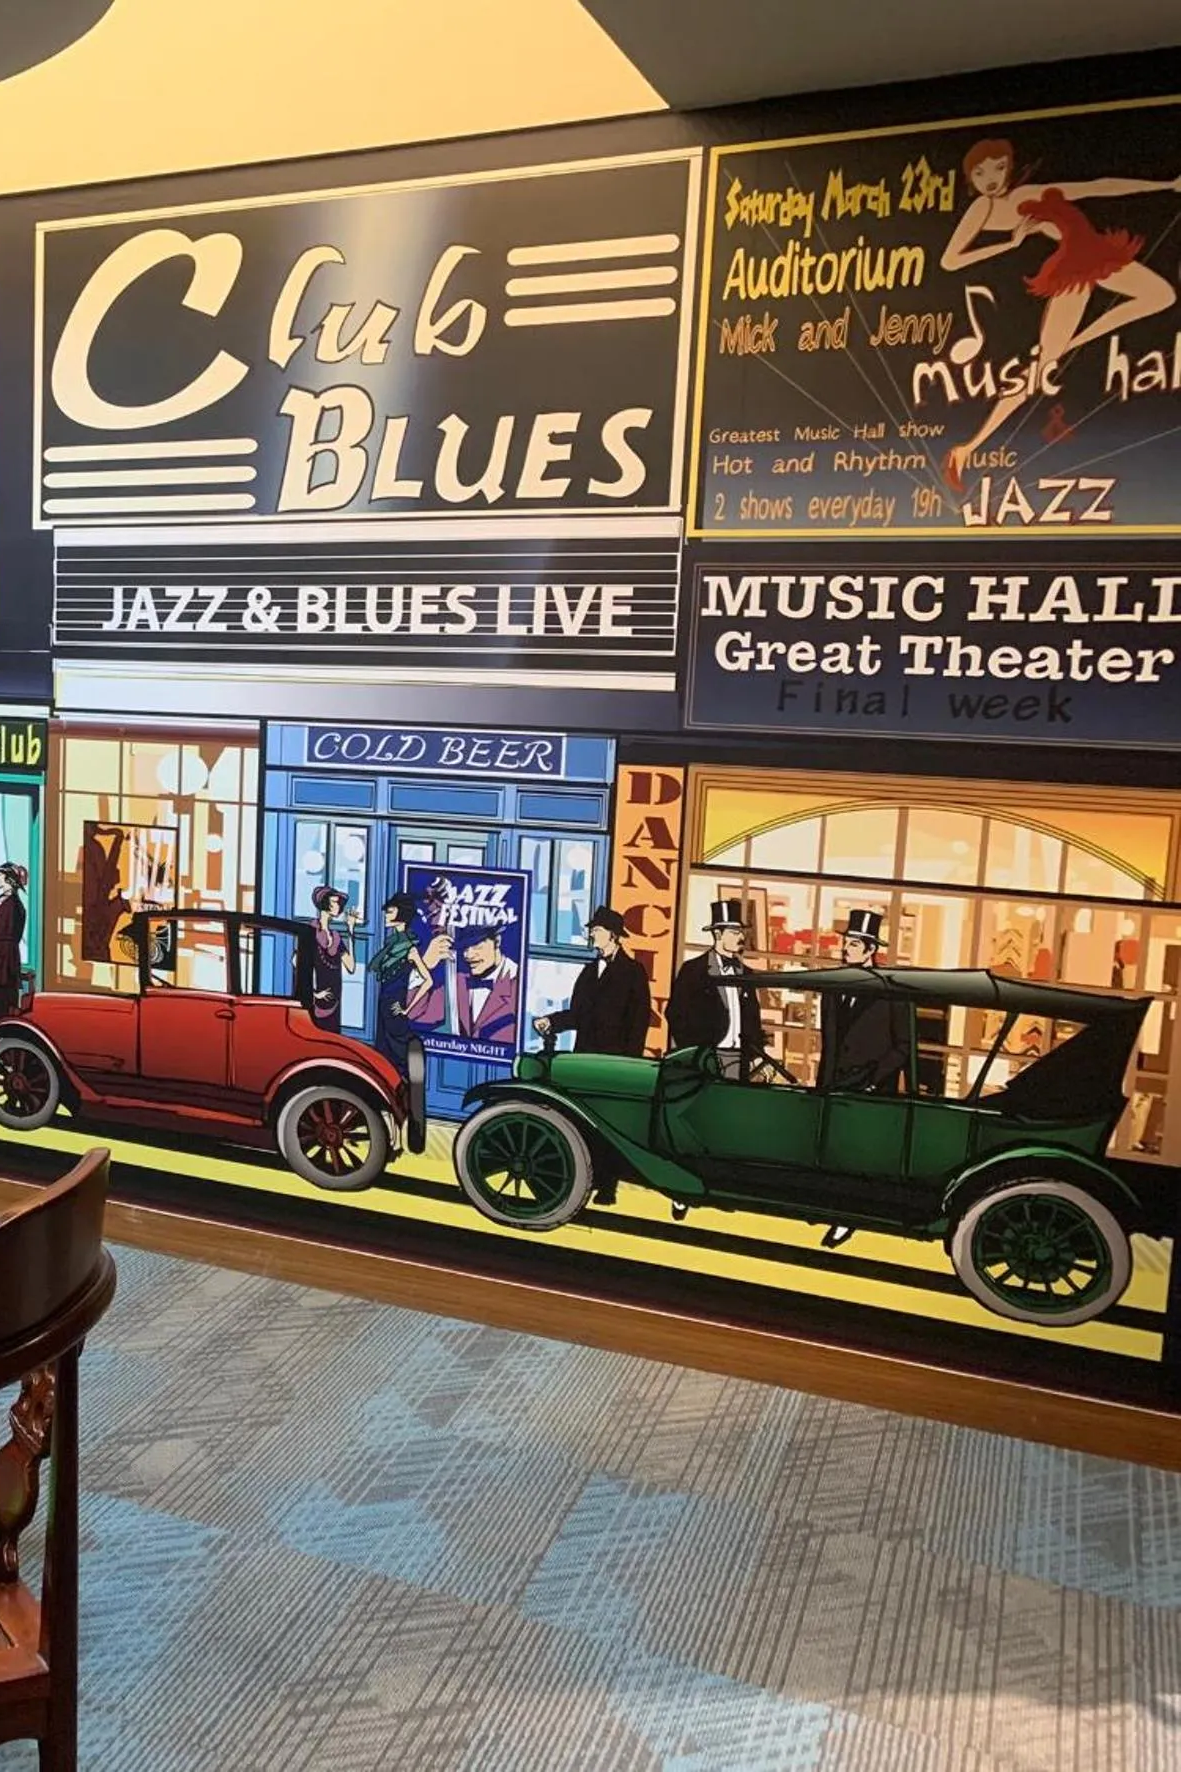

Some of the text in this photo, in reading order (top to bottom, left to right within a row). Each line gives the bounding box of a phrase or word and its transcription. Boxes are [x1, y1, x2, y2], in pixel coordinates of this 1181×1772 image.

[724, 155, 956, 237] Saturday March 23rd
[723, 236, 925, 301] Auditorium
[51, 228, 488, 431] Club
[719, 305, 953, 356] Mick and Jenny
[276, 383, 654, 514] BLUES
[709, 420, 945, 445] Greatest Music Hall show
[713, 455, 753, 476] Hot
[772, 452, 814, 473] and
[834, 449, 926, 478] Rhythm
[714, 485, 942, 527] 2 shows everyday 19h
[963, 476, 1116, 527] JAZZ
[102, 584, 634, 637] JAZZ & BLUES LIVE
[701, 575, 946, 623] MUSIC
[715, 631, 1175, 683] Great Theater
[776, 678, 1073, 724] Final week
[314, 731, 554, 772] COLD BEER
[438, 904, 518, 928] FESTIVAL
[444, 882, 512, 908] JAZZ
[420, 1034, 508, 1057] aturday NIGHT
